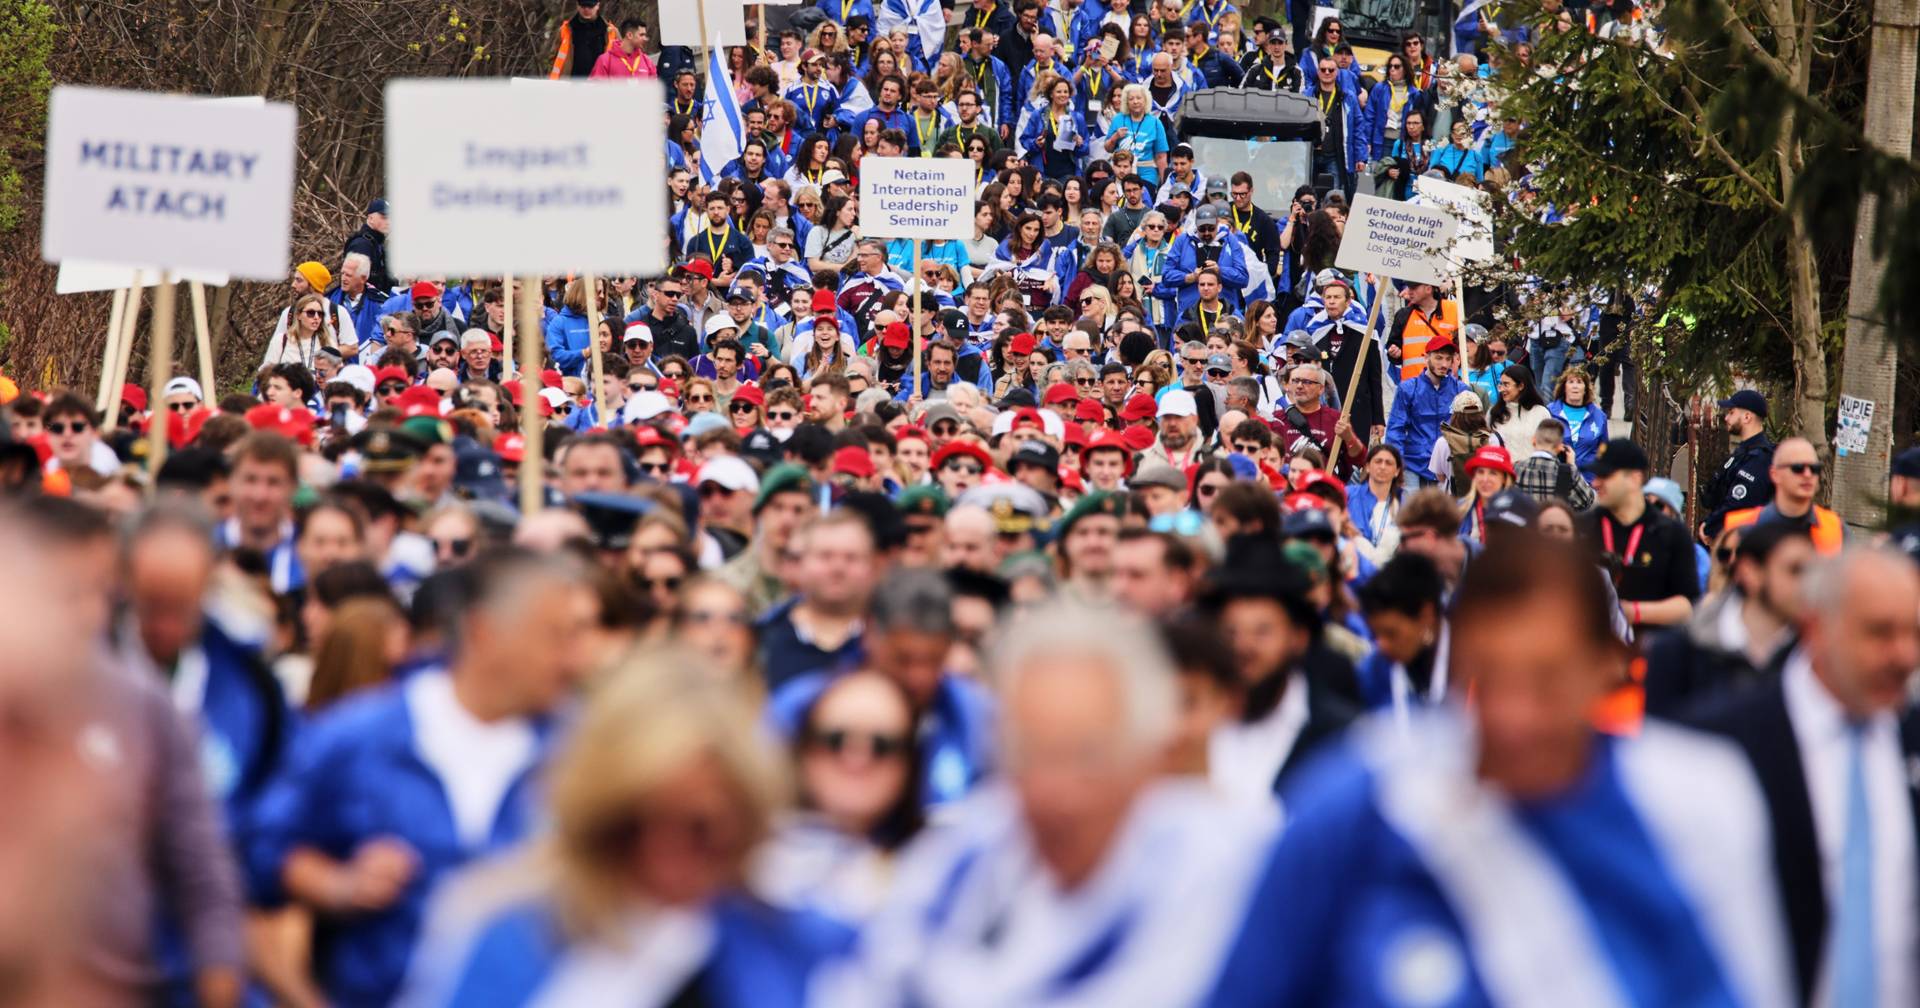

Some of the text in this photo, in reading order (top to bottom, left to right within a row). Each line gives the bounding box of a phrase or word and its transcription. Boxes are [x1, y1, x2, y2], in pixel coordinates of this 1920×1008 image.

[80, 139, 259, 178] MILITARY
[464, 141, 588, 171] Impact
[894, 169, 945, 181] Netaim
[432, 180, 624, 214] Delegation
[872, 183, 967, 197] International
[107, 184, 226, 220] ATACH
[880, 199, 959, 214] Leadership
[889, 214, 949, 227] Seminar
[1366, 206, 1443, 229] deToledo High
[1367, 218, 1435, 239] School Adult
[1366, 242, 1423, 261] Los Angeles
[1381, 257, 1402, 268] USA
[1840, 397, 1873, 417] KUPIE
